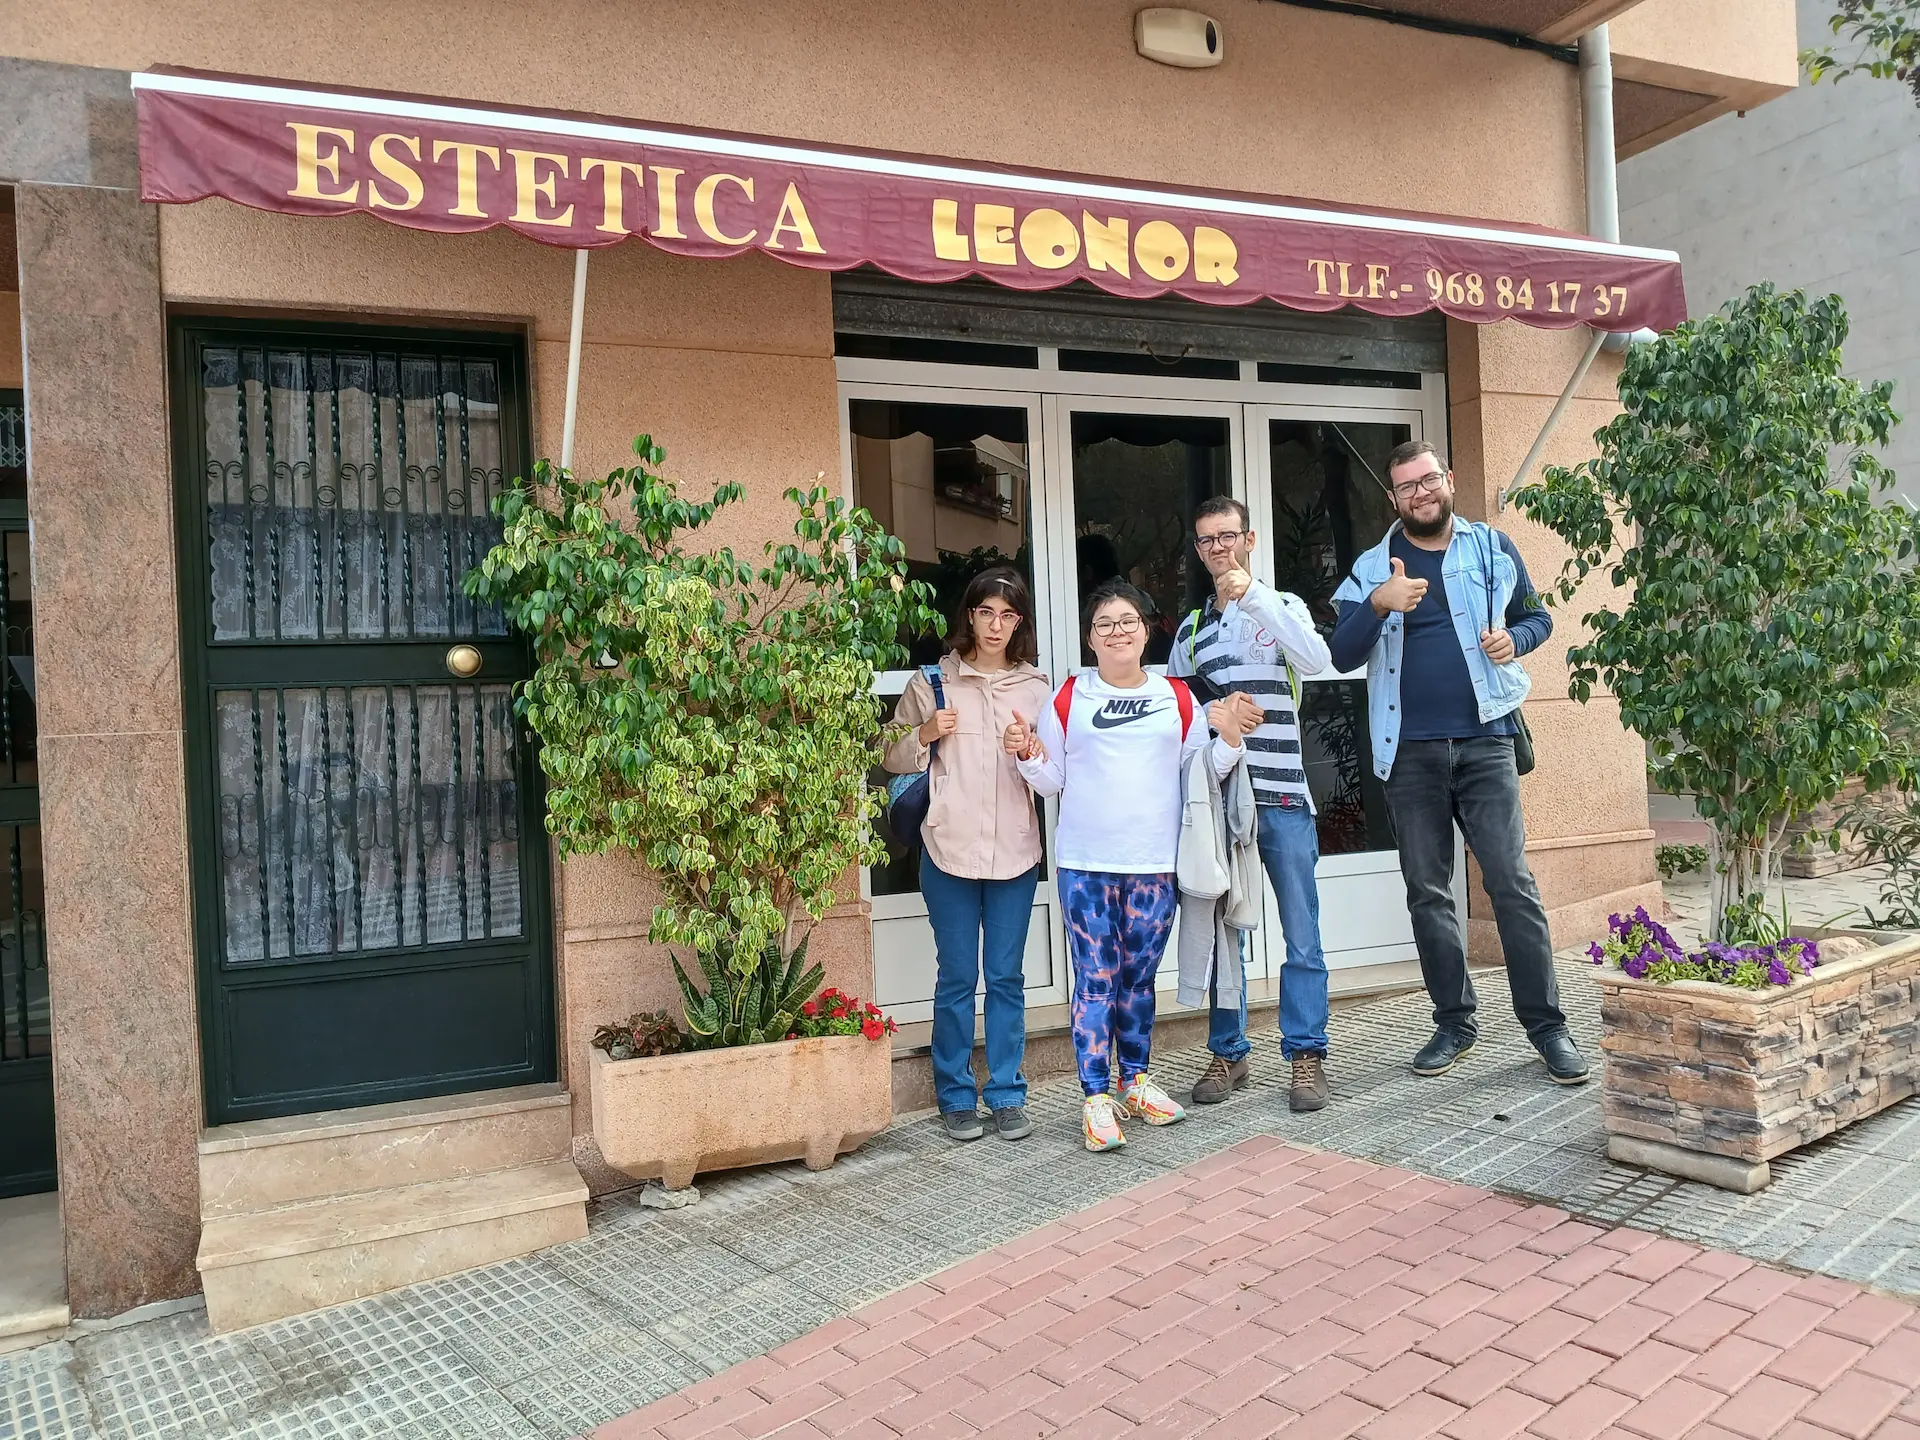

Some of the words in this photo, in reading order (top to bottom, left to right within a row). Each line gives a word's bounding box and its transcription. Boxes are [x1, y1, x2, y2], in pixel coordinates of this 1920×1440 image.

[286, 122, 826, 254] ESTETICA
[932, 199, 1240, 286] LEONOR
[1308, 259, 1413, 299] TLF.-
[1426, 268, 1485, 307] 968
[1495, 276, 1535, 310] 84
[1546, 281, 1581, 313] 17
[1593, 284, 1627, 316] 37
[1103, 699, 1152, 714] NIKE
